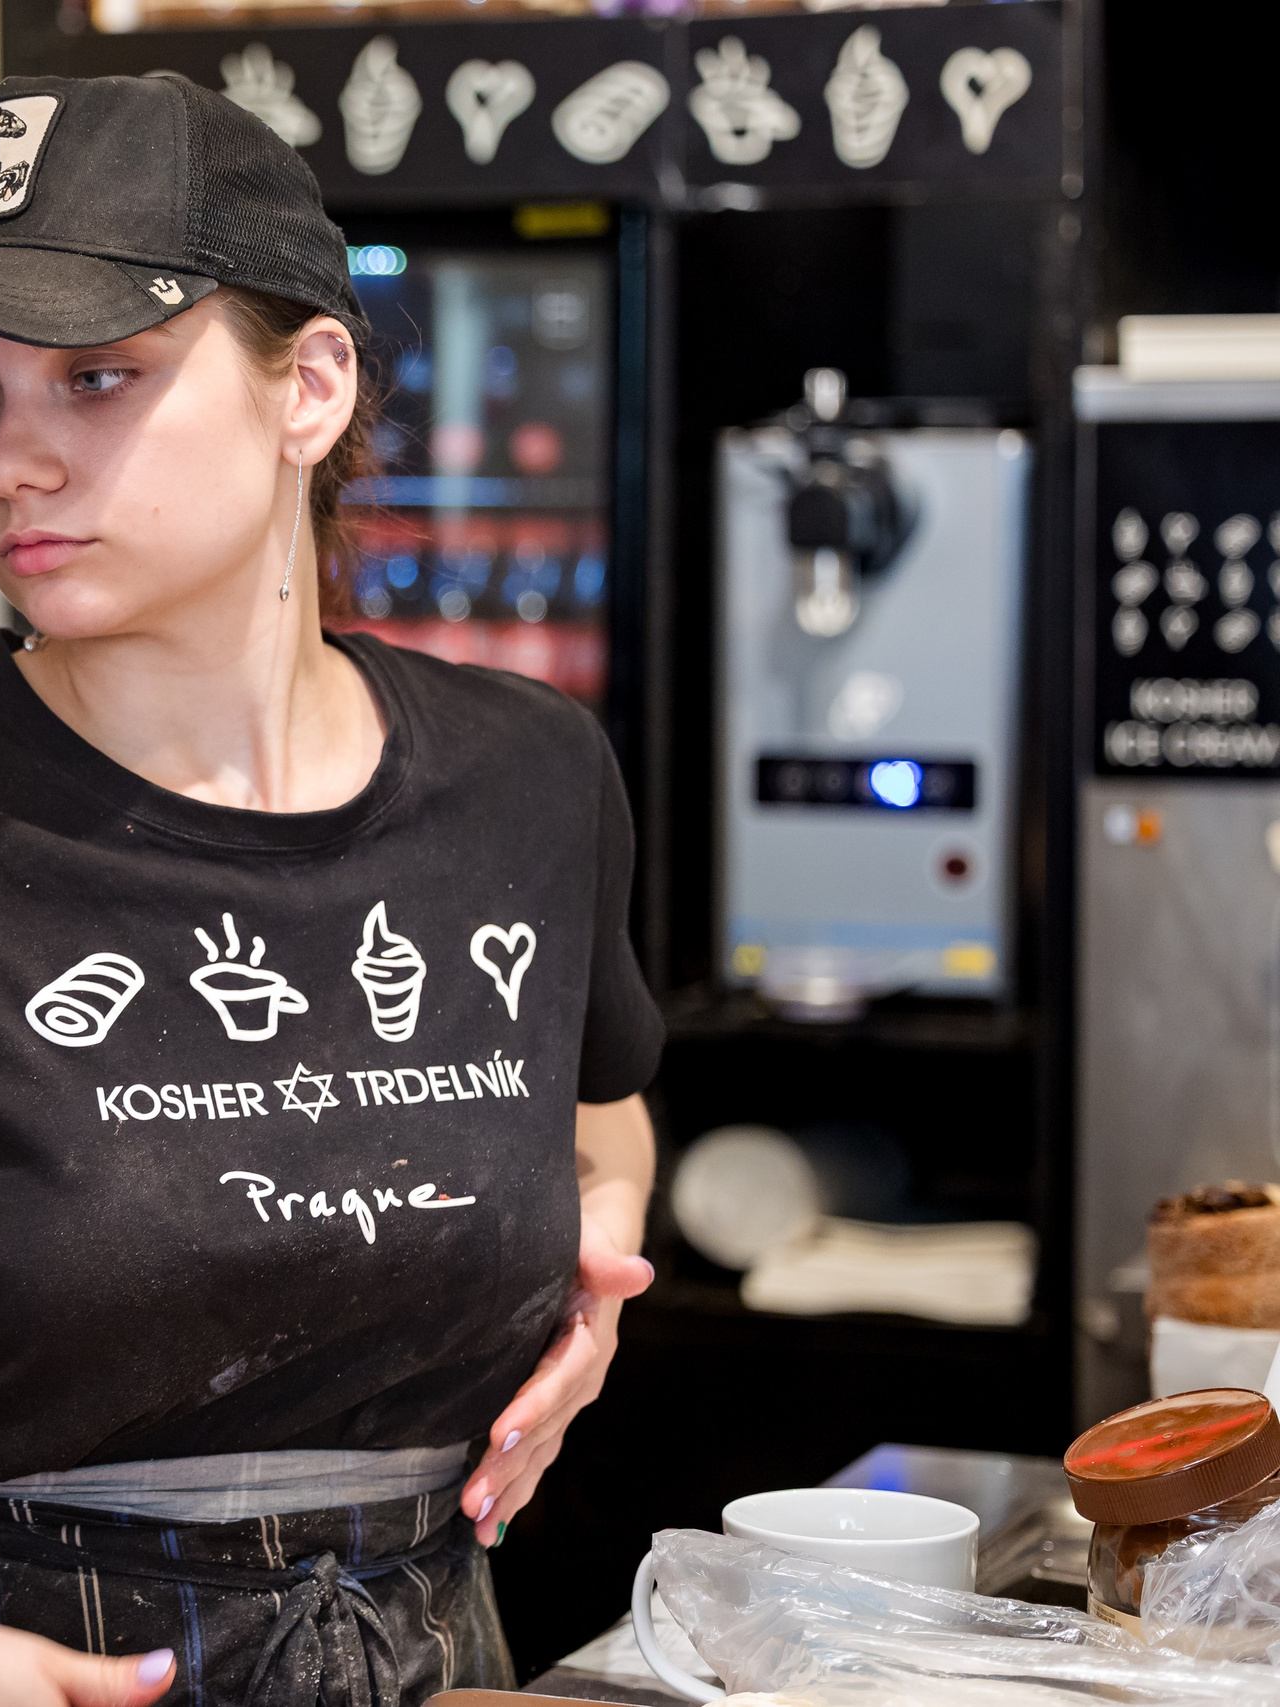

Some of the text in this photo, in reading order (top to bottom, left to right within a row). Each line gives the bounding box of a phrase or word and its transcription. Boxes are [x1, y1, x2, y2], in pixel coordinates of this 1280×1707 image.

[95, 1049, 531, 1124] KOSHER TRDELNÍK
[219, 1170, 477, 1245] Prague
